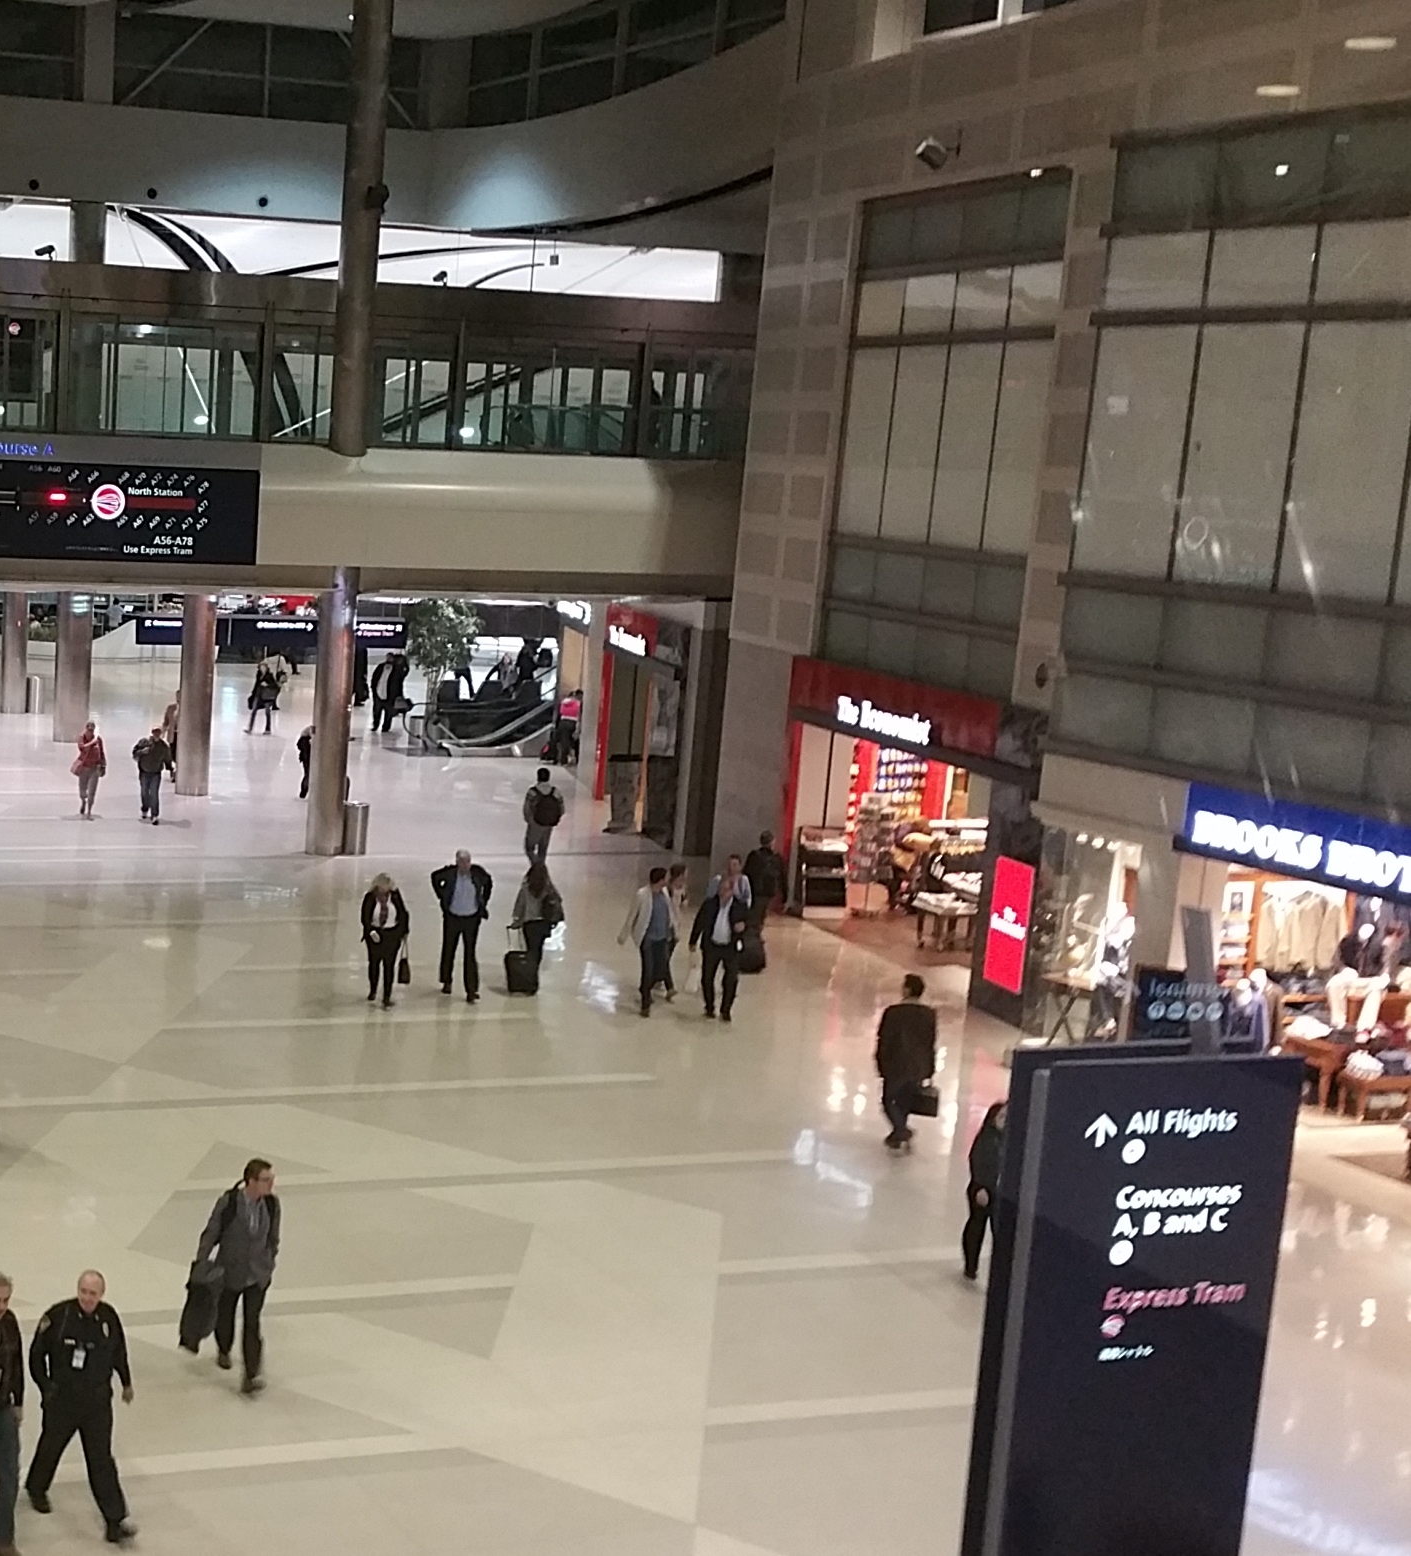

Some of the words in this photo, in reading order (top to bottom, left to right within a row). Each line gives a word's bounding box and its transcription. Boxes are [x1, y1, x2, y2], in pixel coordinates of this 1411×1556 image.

[42, 442, 54, 456] A
[135, 472, 147, 486] A70
[128, 487, 152, 496] North
[154, 487, 183, 497] Station
[28, 511, 40, 525] A57
[66, 513, 78, 526] A61
[82, 513, 95, 527] A63
[116, 514, 128, 528] A65
[132, 514, 144, 529] A67
[165, 516, 177, 530] A71
[181, 517, 194, 530] A73
[196, 517, 208, 530] A75
[123, 545, 138, 553] Use
[140, 545, 171, 555] Express
[173, 547, 193, 555] Tram
[153, 535, 193, 546] A56-A78
[837, 695, 859, 726] The
[859, 700, 931, 746] Economist
[1191, 809, 1323, 870] BROOKS
[1124, 1109, 1160, 1135] All
[1162, 1107, 1238, 1139] Flights
[1115, 1184, 1242, 1210] Concourses
[1111, 1213, 1139, 1239] A,
[1142, 1211, 1161, 1235] B
[1162, 1207, 1209, 1235] and
[1210, 1207, 1230, 1232] C
[1102, 1286, 1190, 1315] Express
[1193, 1280, 1248, 1305] Tram
